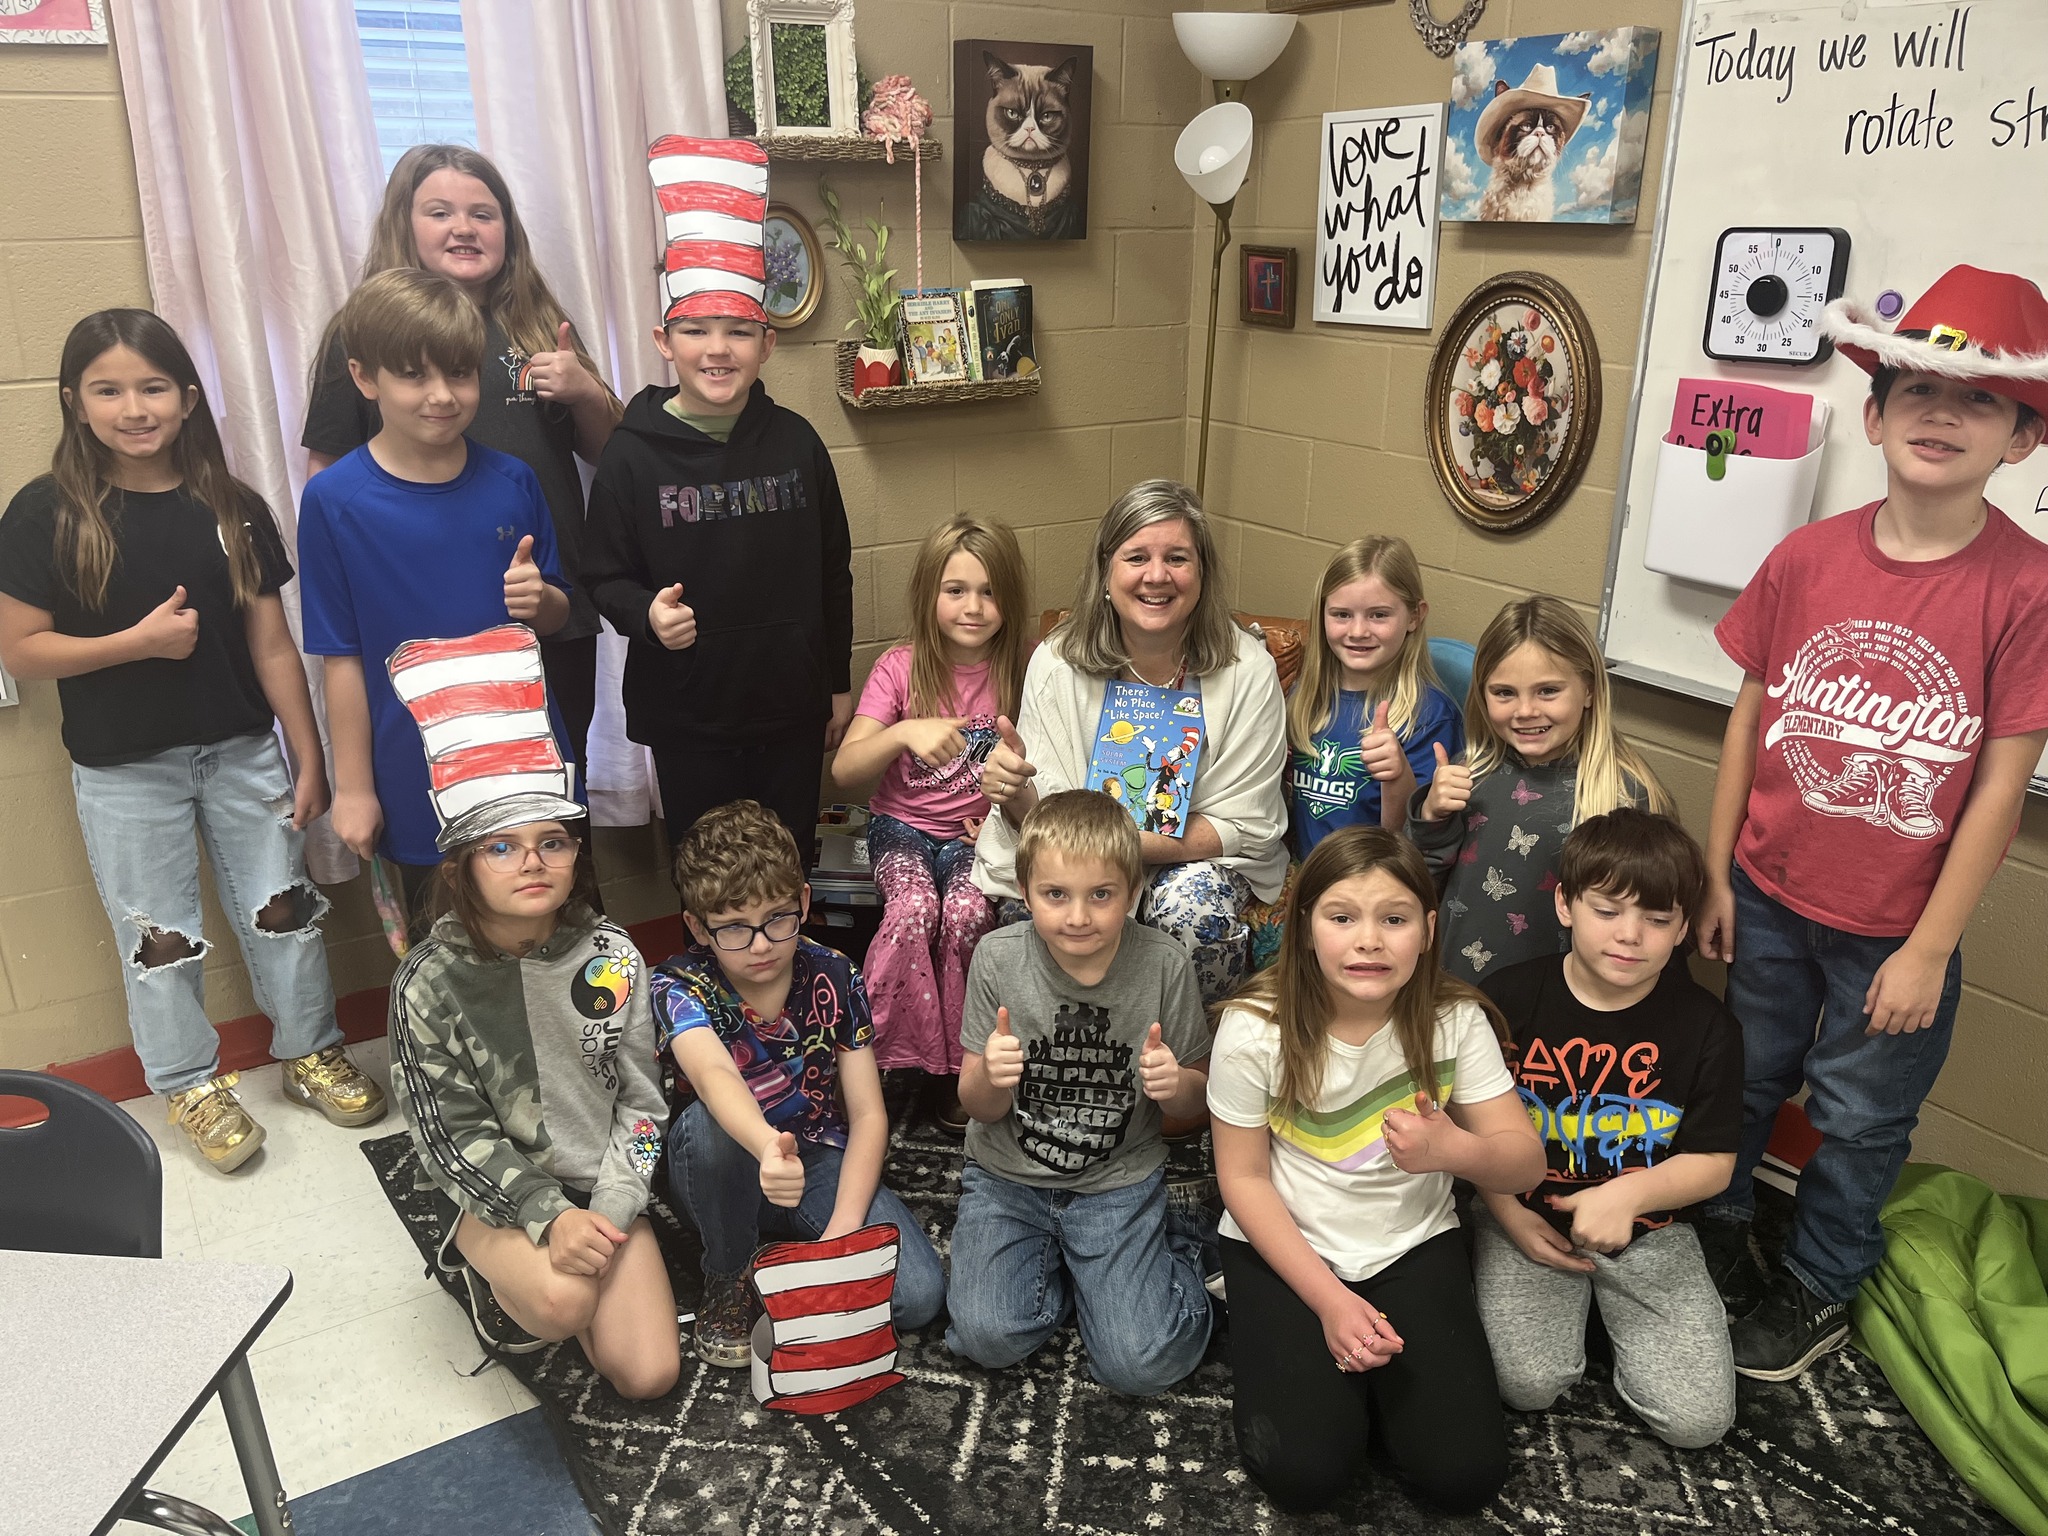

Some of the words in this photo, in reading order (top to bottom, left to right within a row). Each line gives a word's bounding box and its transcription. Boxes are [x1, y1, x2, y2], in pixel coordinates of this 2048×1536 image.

[1695, 28, 1796, 104] Today
[1819, 33, 1868, 72] we
[1845, 88, 1955, 155] rotate
[1325, 126, 1430, 241] what
[1748, 245, 1758, 253] 55
[1799, 245, 1804, 253] 5
[1324, 240, 1387, 313] you
[1374, 231, 1423, 311] do
[1729, 264, 1738, 273] 50
[1812, 266, 1822, 274] 10
[1720, 290, 1729, 298] 45
[1814, 293, 1824, 302] 15
[1000, 306, 1020, 325] ONLY
[1721, 315, 1731, 324] 40
[1802, 319, 1812, 328] 20
[1735, 336, 1745, 344] 35
[1782, 338, 1792, 347] 25
[1757, 344, 1767, 352] 30
[1691, 394, 1763, 437] Extra
[659, 473, 806, 528] FORTNITE
[1853, 620, 1873, 628] IELD
[1875, 620, 1893, 632] DAY
[1914, 635, 1936, 654] FIELD
[1933, 651, 1949, 667] DAY
[1944, 666, 1961, 688] 2023
[1955, 691, 1968, 713] FIELD
[1874, 633, 1892, 643] FIELD
[1892, 638, 1908, 649] DAY
[1906, 645, 1925, 661] 2023
[1924, 661, 1941, 679] FIELD
[1936, 678, 1949, 692] DAY
[1115, 685, 1150, 697] There's
[1114, 697, 1128, 707] No
[1131, 698, 1156, 709] Place
[1767, 650, 1983, 749] Huntington
[1110, 710, 1130, 720] Like
[1132, 709, 1165, 721] Space!
[1783, 715, 1844, 739] ELEMENTARY
[1050, 1046, 1114, 1064] BORN
[1029, 1063, 1058, 1081] TO
[1063, 1067, 1127, 1085] PLAY
[1026, 1082, 1127, 1109] ROBLOX
